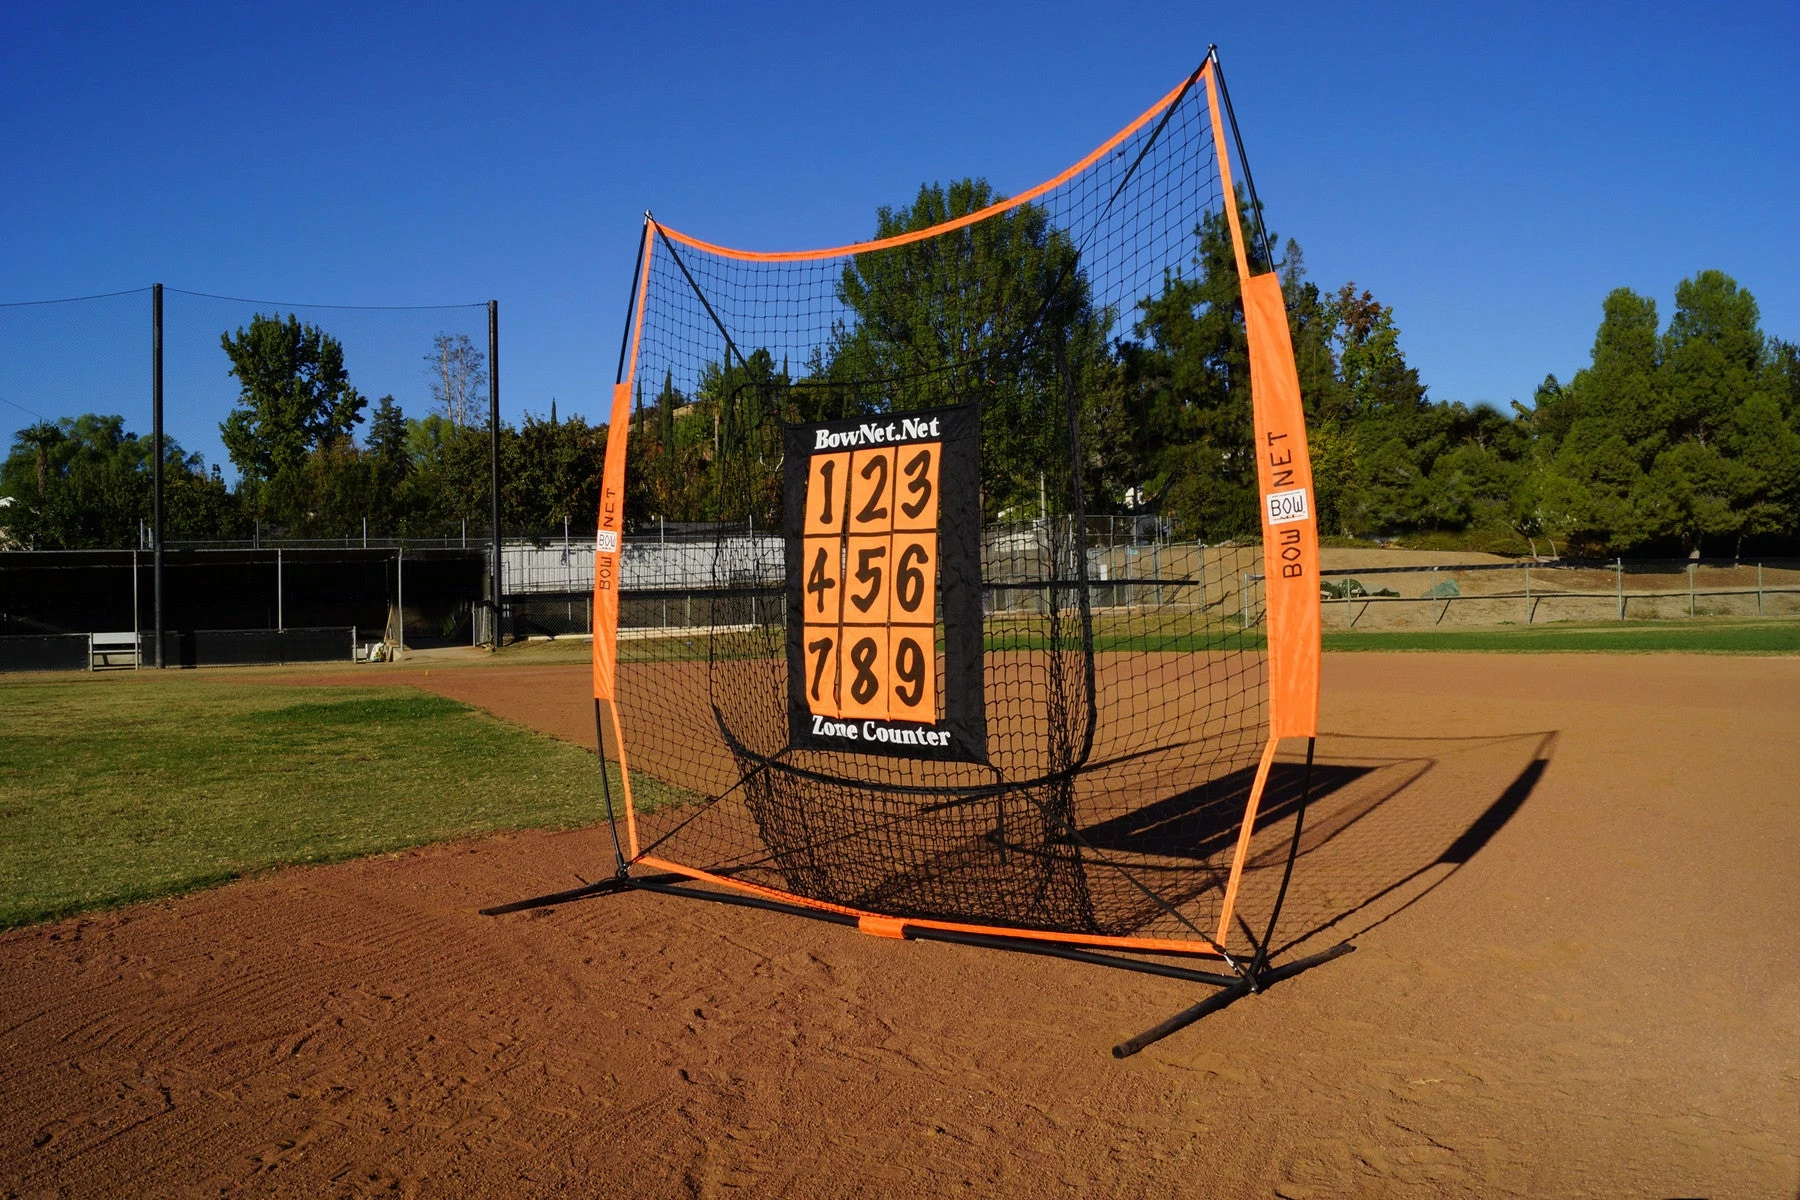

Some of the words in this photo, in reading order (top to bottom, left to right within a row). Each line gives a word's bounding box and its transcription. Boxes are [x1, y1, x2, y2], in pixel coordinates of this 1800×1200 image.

[815, 417, 940, 449] BowNet.Net
[1268, 432, 1294, 487] NET
[603, 488, 615, 527] NET
[820, 460, 835, 524] 1
[856, 455, 887, 523] 2
[901, 449, 932, 519] 3
[1271, 495, 1303, 517] BOW
[599, 556, 612, 590] BOW
[1280, 529, 1302, 579] BOW
[807, 547, 835, 613] 4
[850, 546, 886, 613] 5
[896, 543, 929, 613] 6
[808, 637, 833, 701] 7
[851, 637, 879, 705] 8
[895, 637, 926, 707] 9
[812, 715, 858, 740] Zone
[862, 720, 951, 746] Counter
